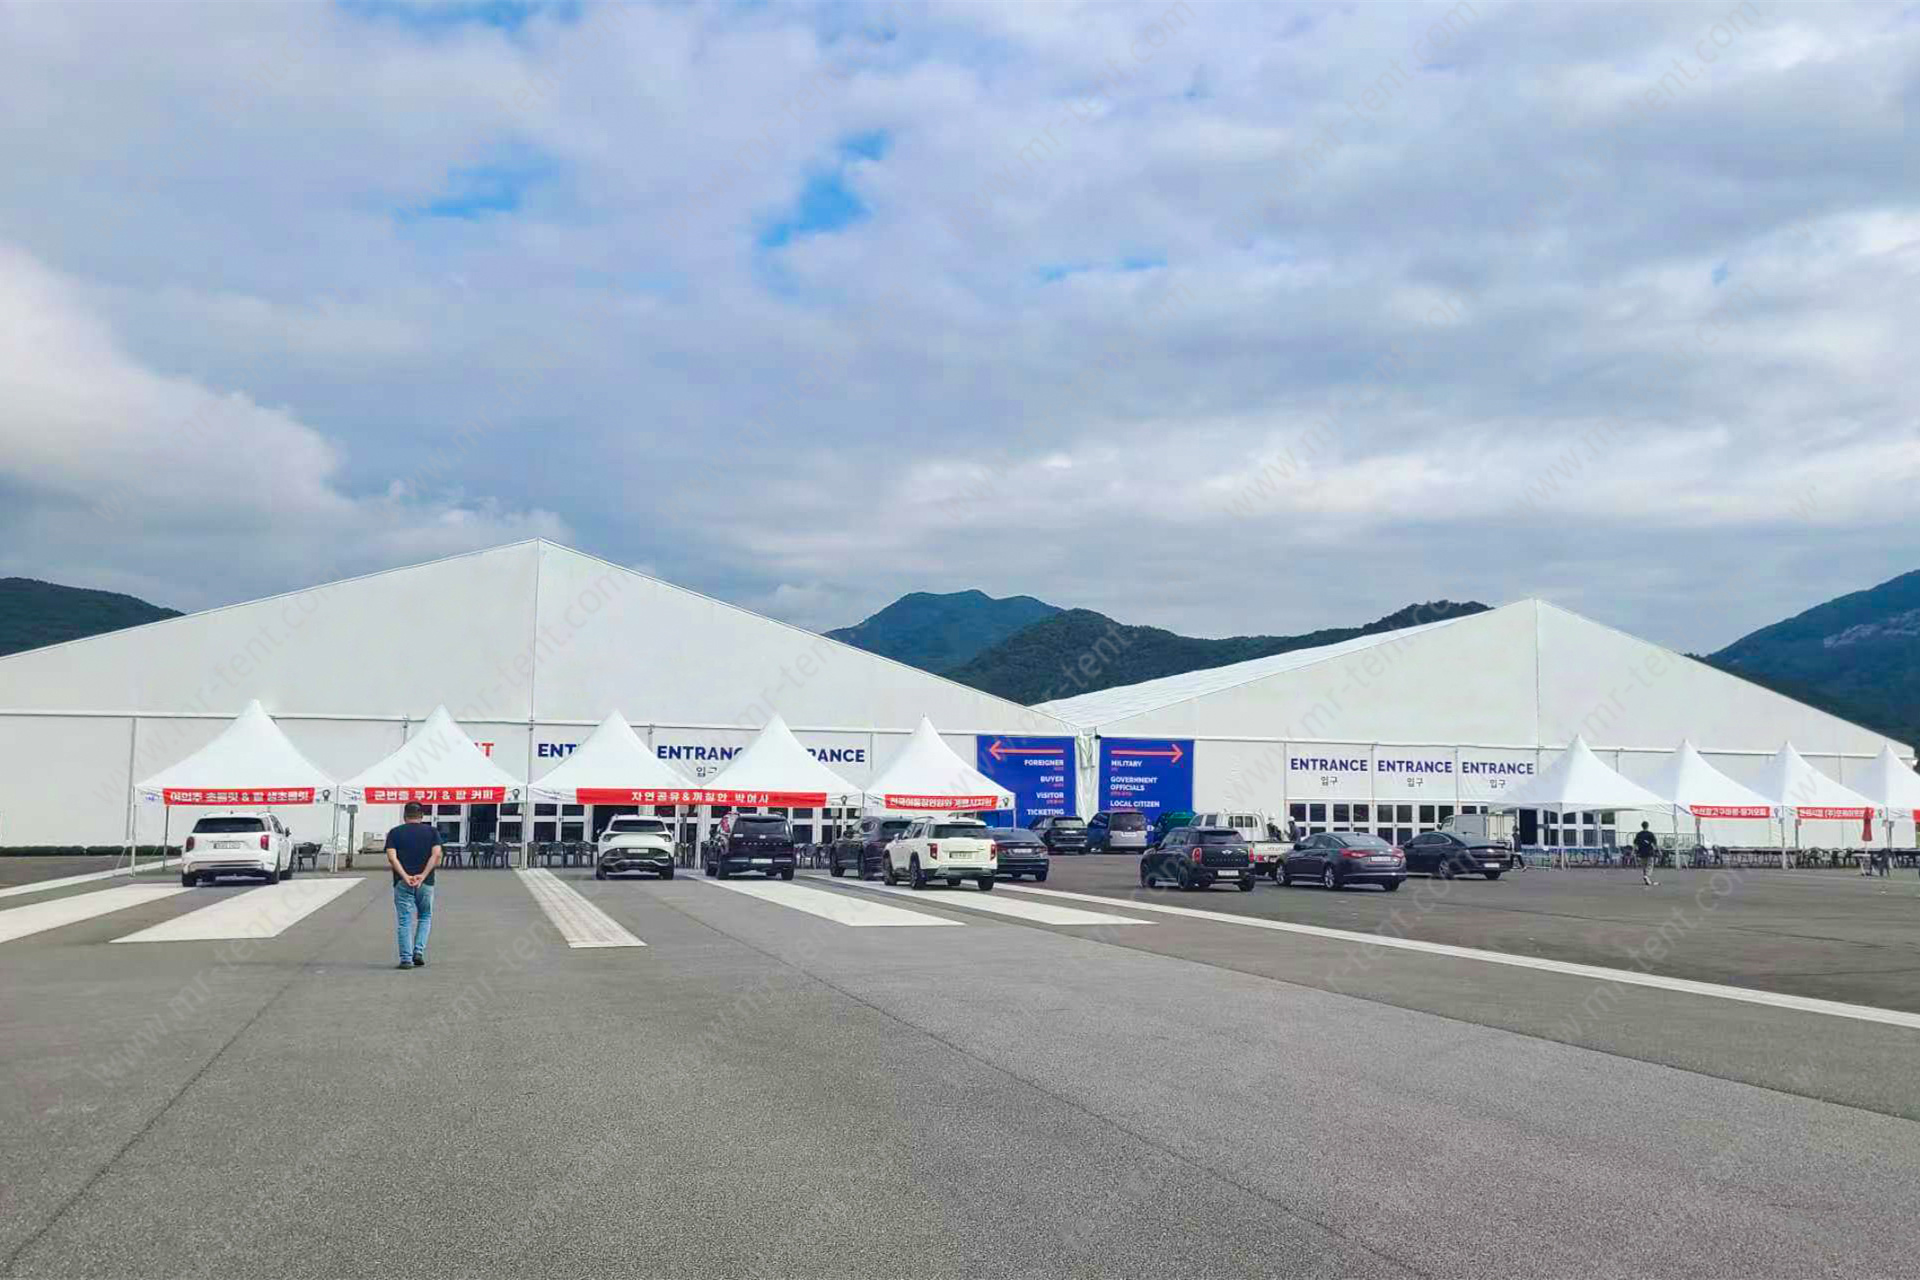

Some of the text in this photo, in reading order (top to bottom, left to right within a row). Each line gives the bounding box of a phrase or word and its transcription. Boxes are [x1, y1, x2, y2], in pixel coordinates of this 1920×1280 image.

[537, 743, 581, 758] ENT
[1024, 759, 1065, 767] FOREIGNER
[1111, 760, 1143, 768] MILITARY
[1290, 758, 1369, 772] ENTRANCE
[1377, 760, 1453, 773] ENTRANCE
[1461, 762, 1534, 775] ENTRANCE
[1040, 775, 1065, 783] BUYER
[1110, 776, 1159, 784] GOVERNMENT
[1320, 775, 1338, 786] 입구
[1406, 777, 1424, 787] 입구
[1489, 778, 1506, 789] 입구
[1110, 784, 1146, 792] OFFICIALS
[241, 791, 250, 802] &
[441, 790, 450, 801] &
[470, 790, 493, 801] 커피
[1036, 791, 1065, 799] VISITOR
[1110, 800, 1160, 809] LOCAL CITIZEN
[1027, 808, 1065, 816] TICKETING
